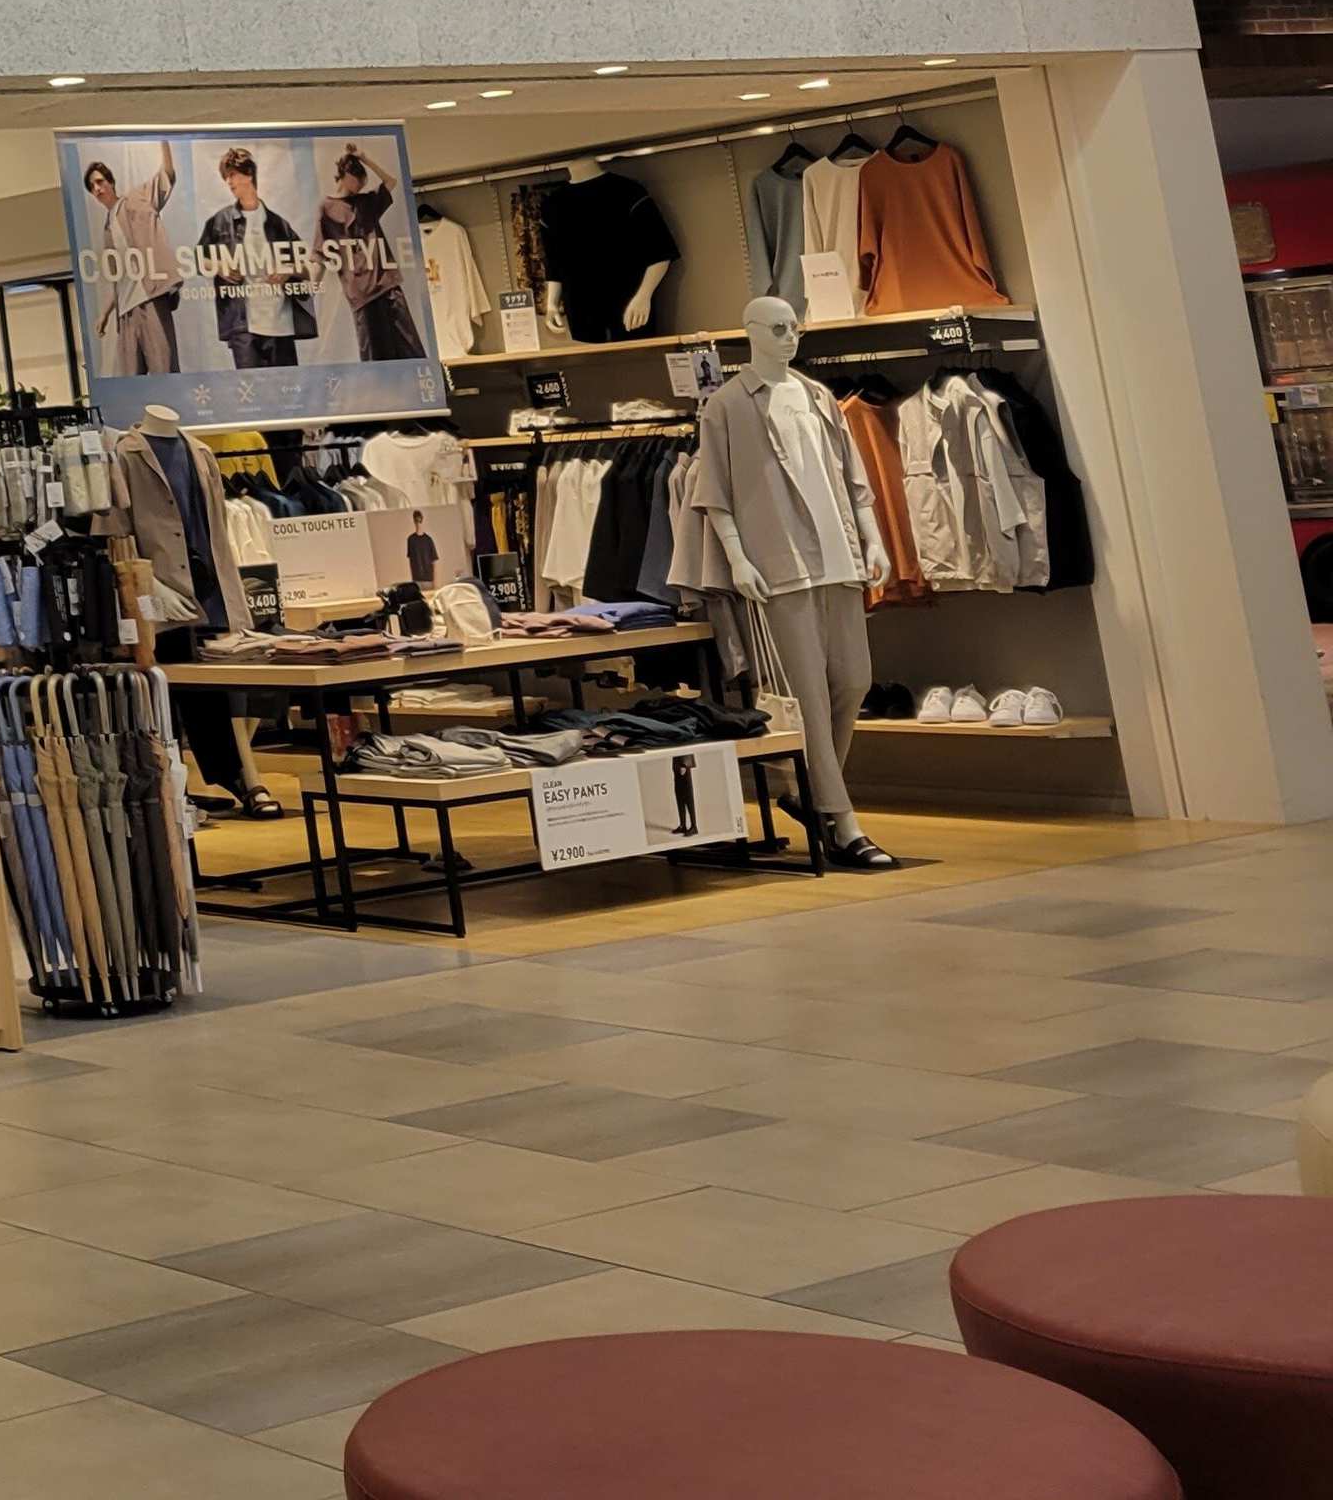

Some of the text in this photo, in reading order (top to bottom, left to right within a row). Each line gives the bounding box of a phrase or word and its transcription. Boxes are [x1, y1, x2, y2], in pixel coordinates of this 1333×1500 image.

[78, 236, 417, 284] COOL SUMMER STYLE
[182, 280, 326, 301] GOOD FUNCTION SERIES
[273, 517, 356, 535] COOL TOUCH TEE
[544, 783, 608, 804] EASY PANTS
